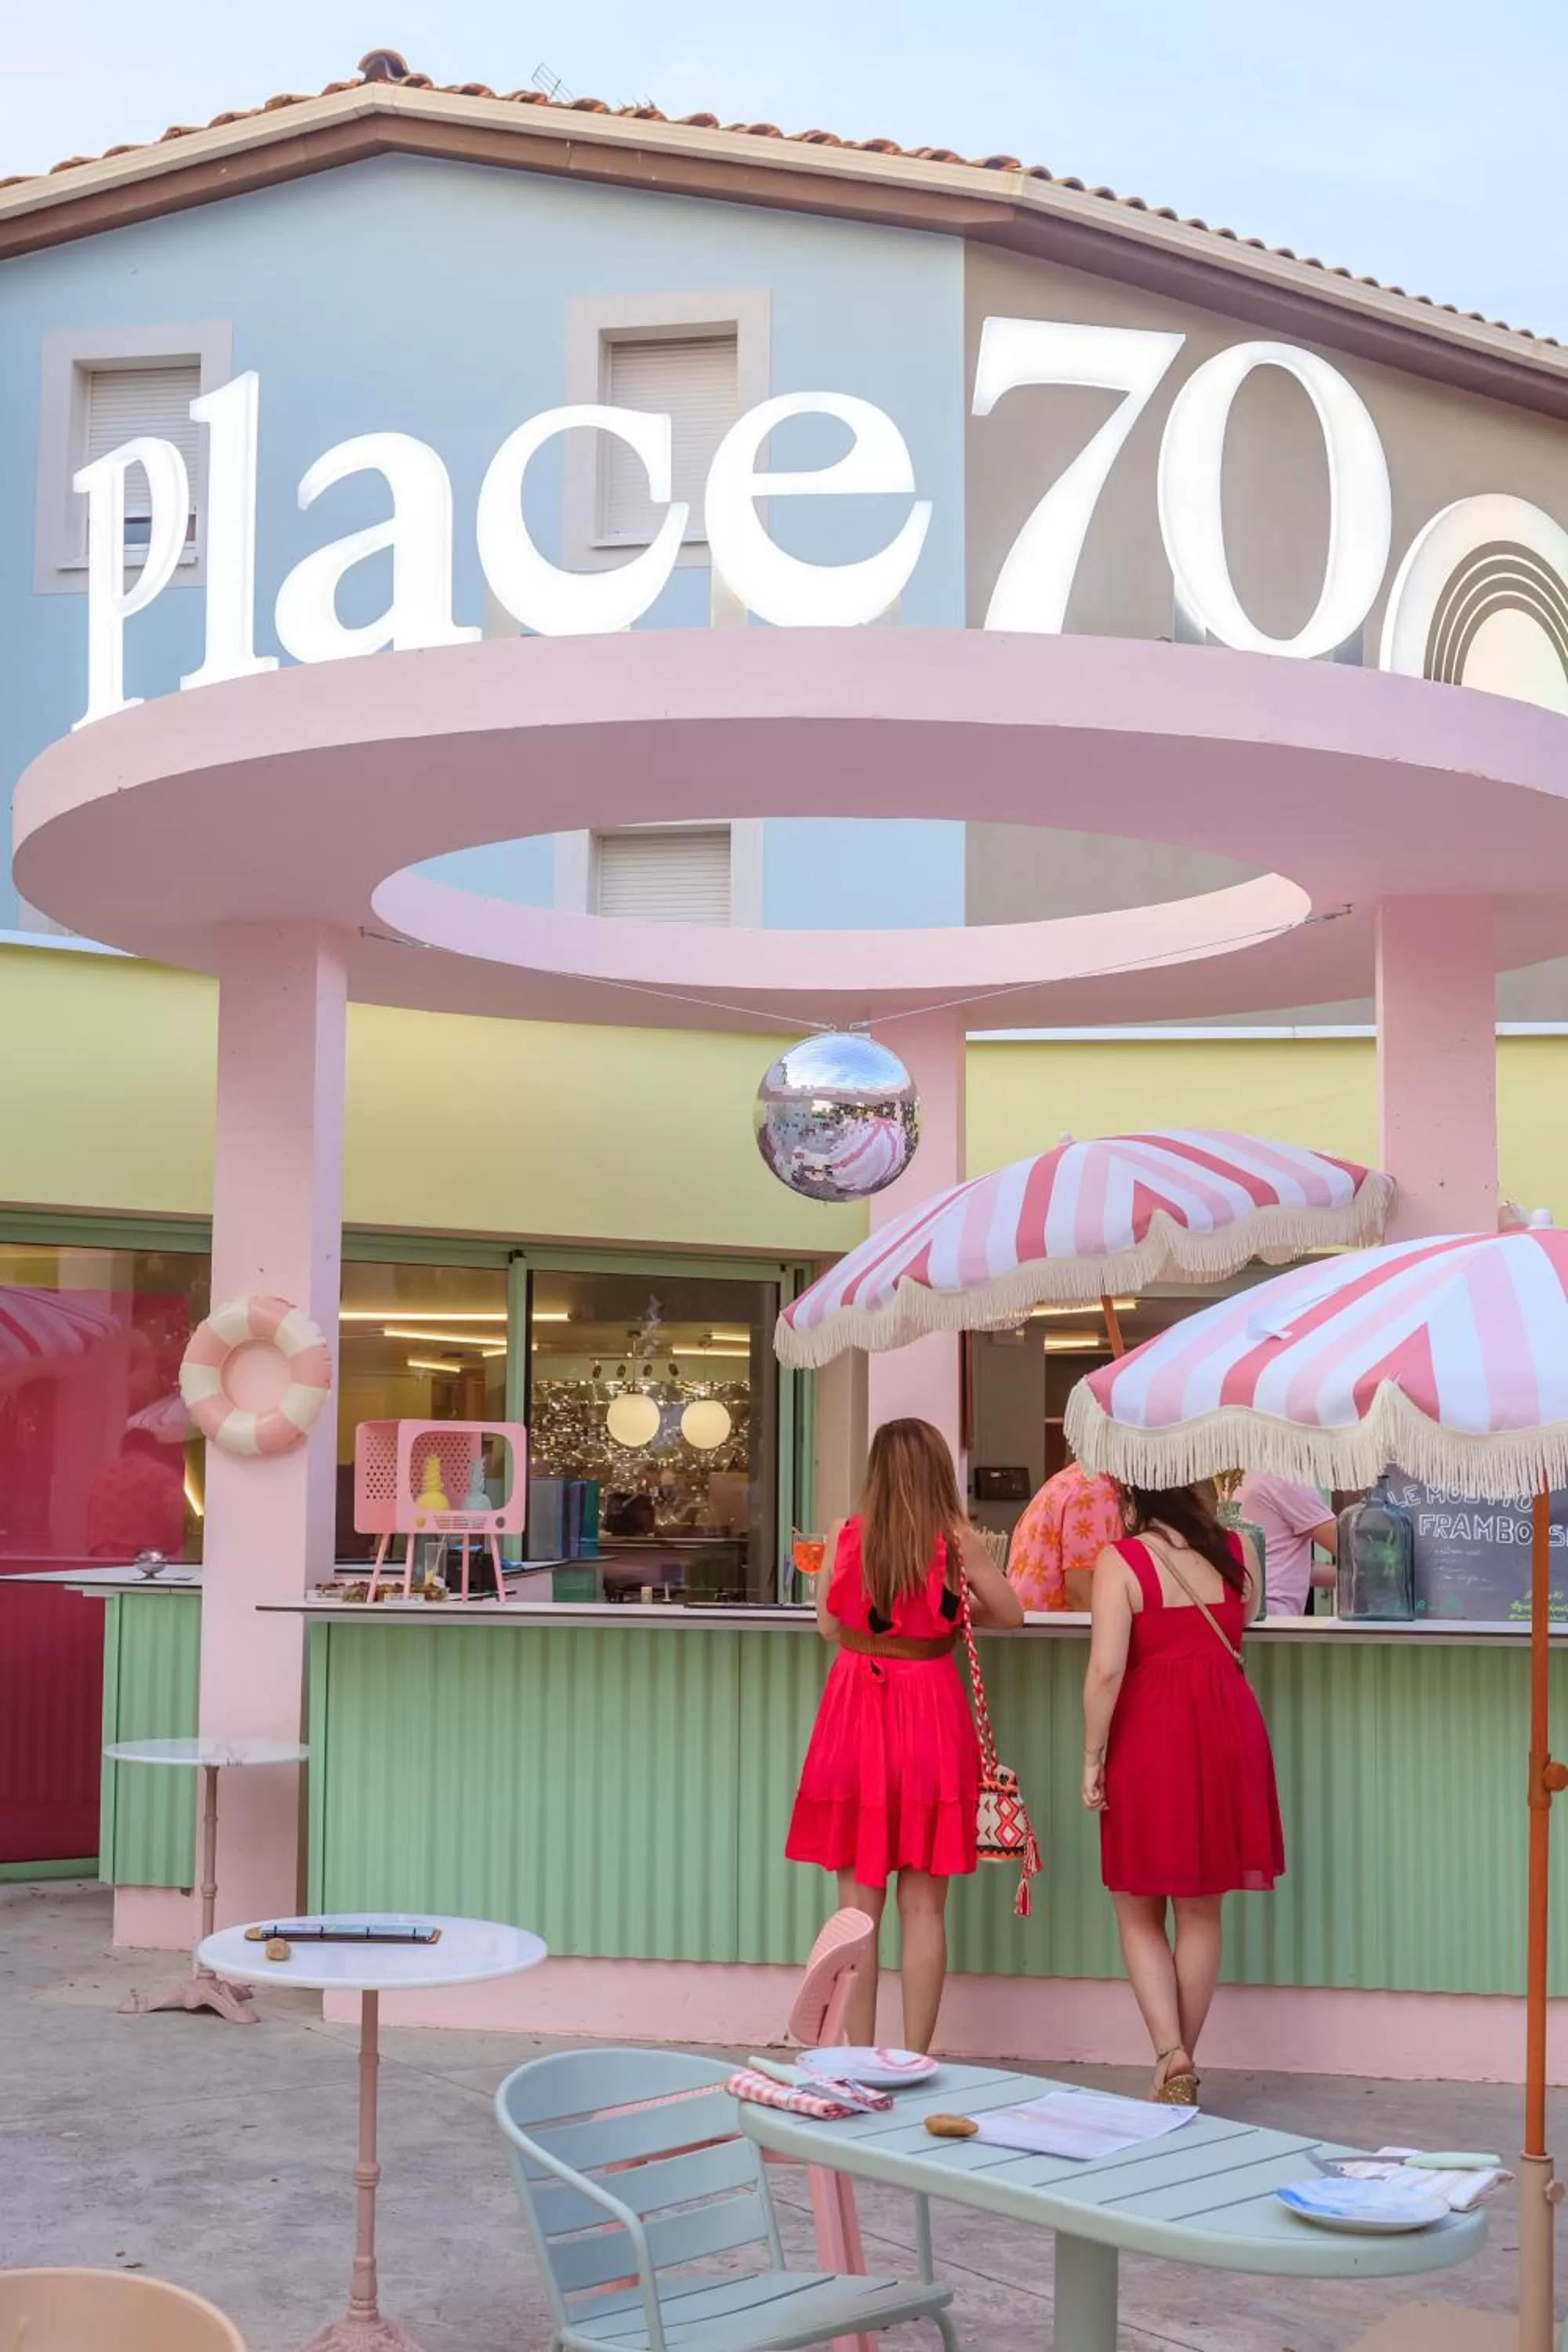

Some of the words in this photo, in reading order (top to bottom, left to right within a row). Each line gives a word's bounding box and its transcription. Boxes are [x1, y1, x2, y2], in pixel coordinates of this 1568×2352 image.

[72, 370, 933, 732] place
[971, 316, 1392, 659] 70
[1387, 1484, 1421, 1508] LE
[1426, 1483, 1534, 1512] MOO
[1418, 1513, 1568, 1547] FRAMBOS
